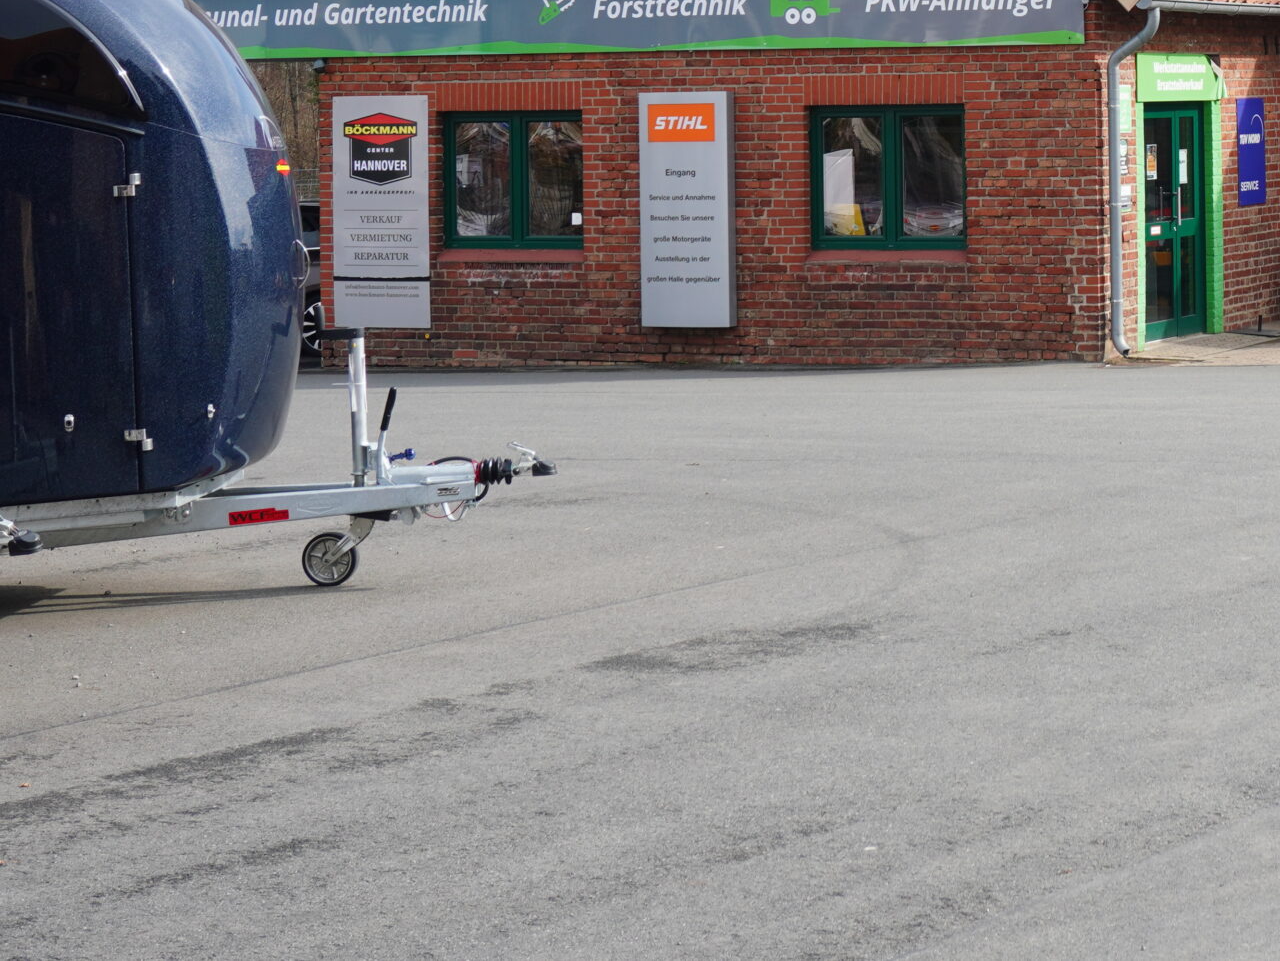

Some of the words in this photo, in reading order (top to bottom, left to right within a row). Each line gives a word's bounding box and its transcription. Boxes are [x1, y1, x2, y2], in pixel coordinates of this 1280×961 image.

[204, 3, 269, 28] unal-
[274, 2, 317, 27] und
[654, 115, 708, 130] STIHL
[344, 123, 417, 135] BÖCKMANN
[353, 159, 407, 171] HANNOVER
[665, 168, 696, 178] Eingang
[1240, 180, 1259, 192] SERVICE
[359, 215, 403, 224] VERKAUF
[350, 233, 413, 243] VERMIETUNG
[671, 235, 711, 243] Motorgeräte
[354, 252, 409, 261] REPARATUR
[655, 255, 690, 264] Ausstellung
[685, 275, 721, 283] gegenüber
